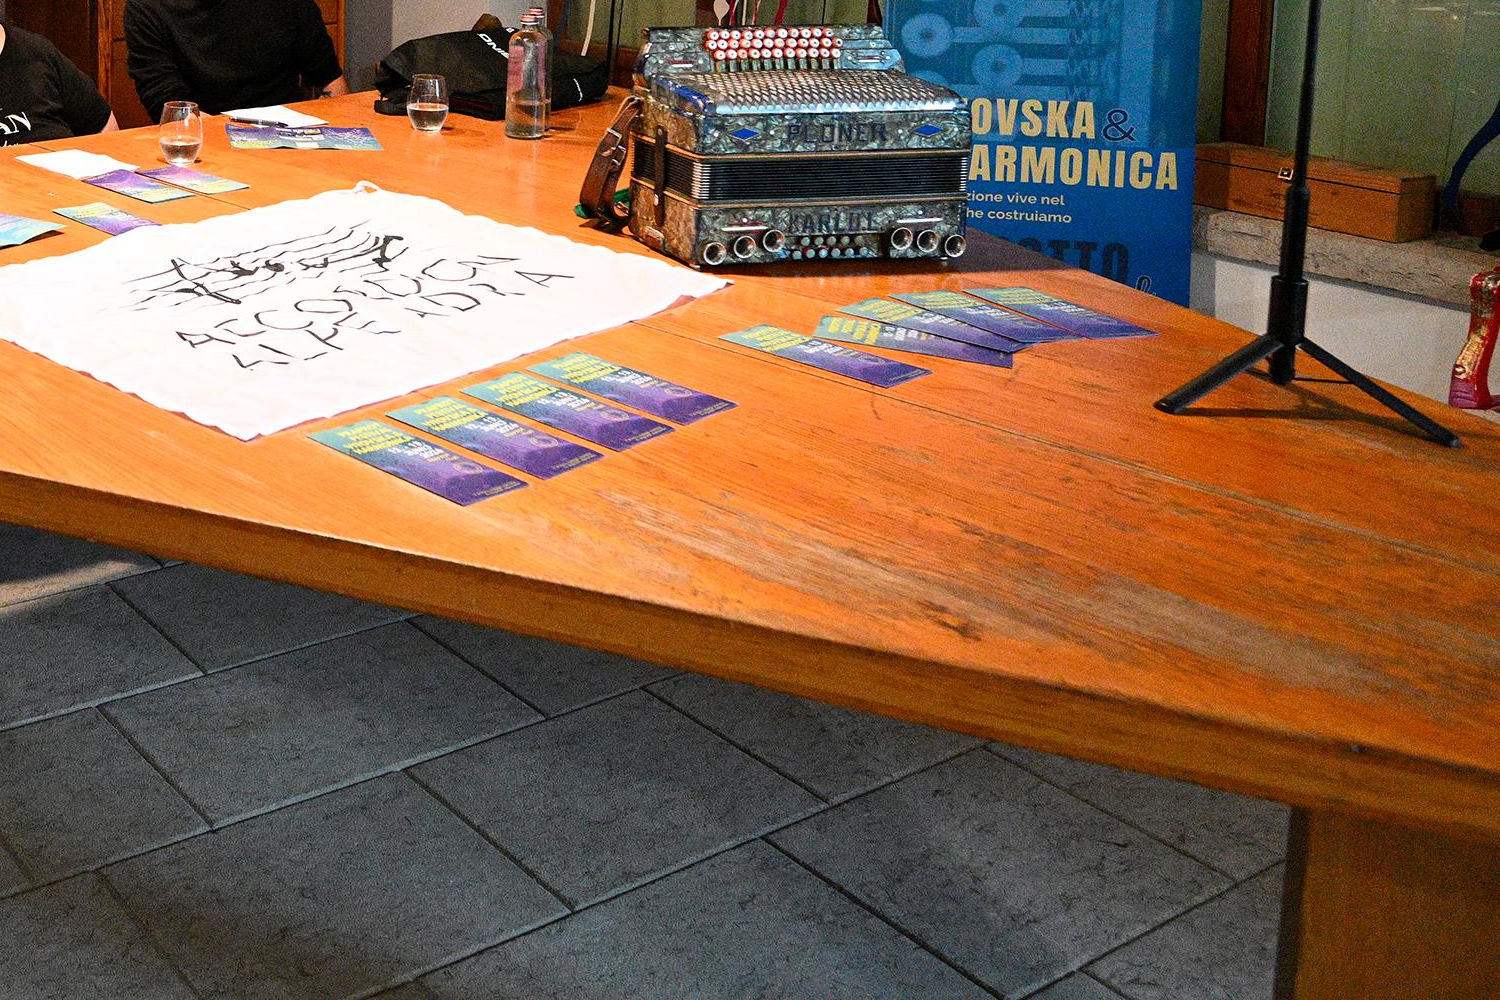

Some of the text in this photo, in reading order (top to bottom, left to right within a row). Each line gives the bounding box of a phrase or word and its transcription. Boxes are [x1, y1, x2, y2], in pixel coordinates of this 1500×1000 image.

[966, 98, 1136, 142] OVSKA &
[787, 121, 886, 143] PLONER
[968, 144, 1178, 191] ARMONICA
[1007, 193, 1037, 205] vive
[1041, 194, 1065, 206] nel
[966, 207, 1072, 224] he costruiamo
